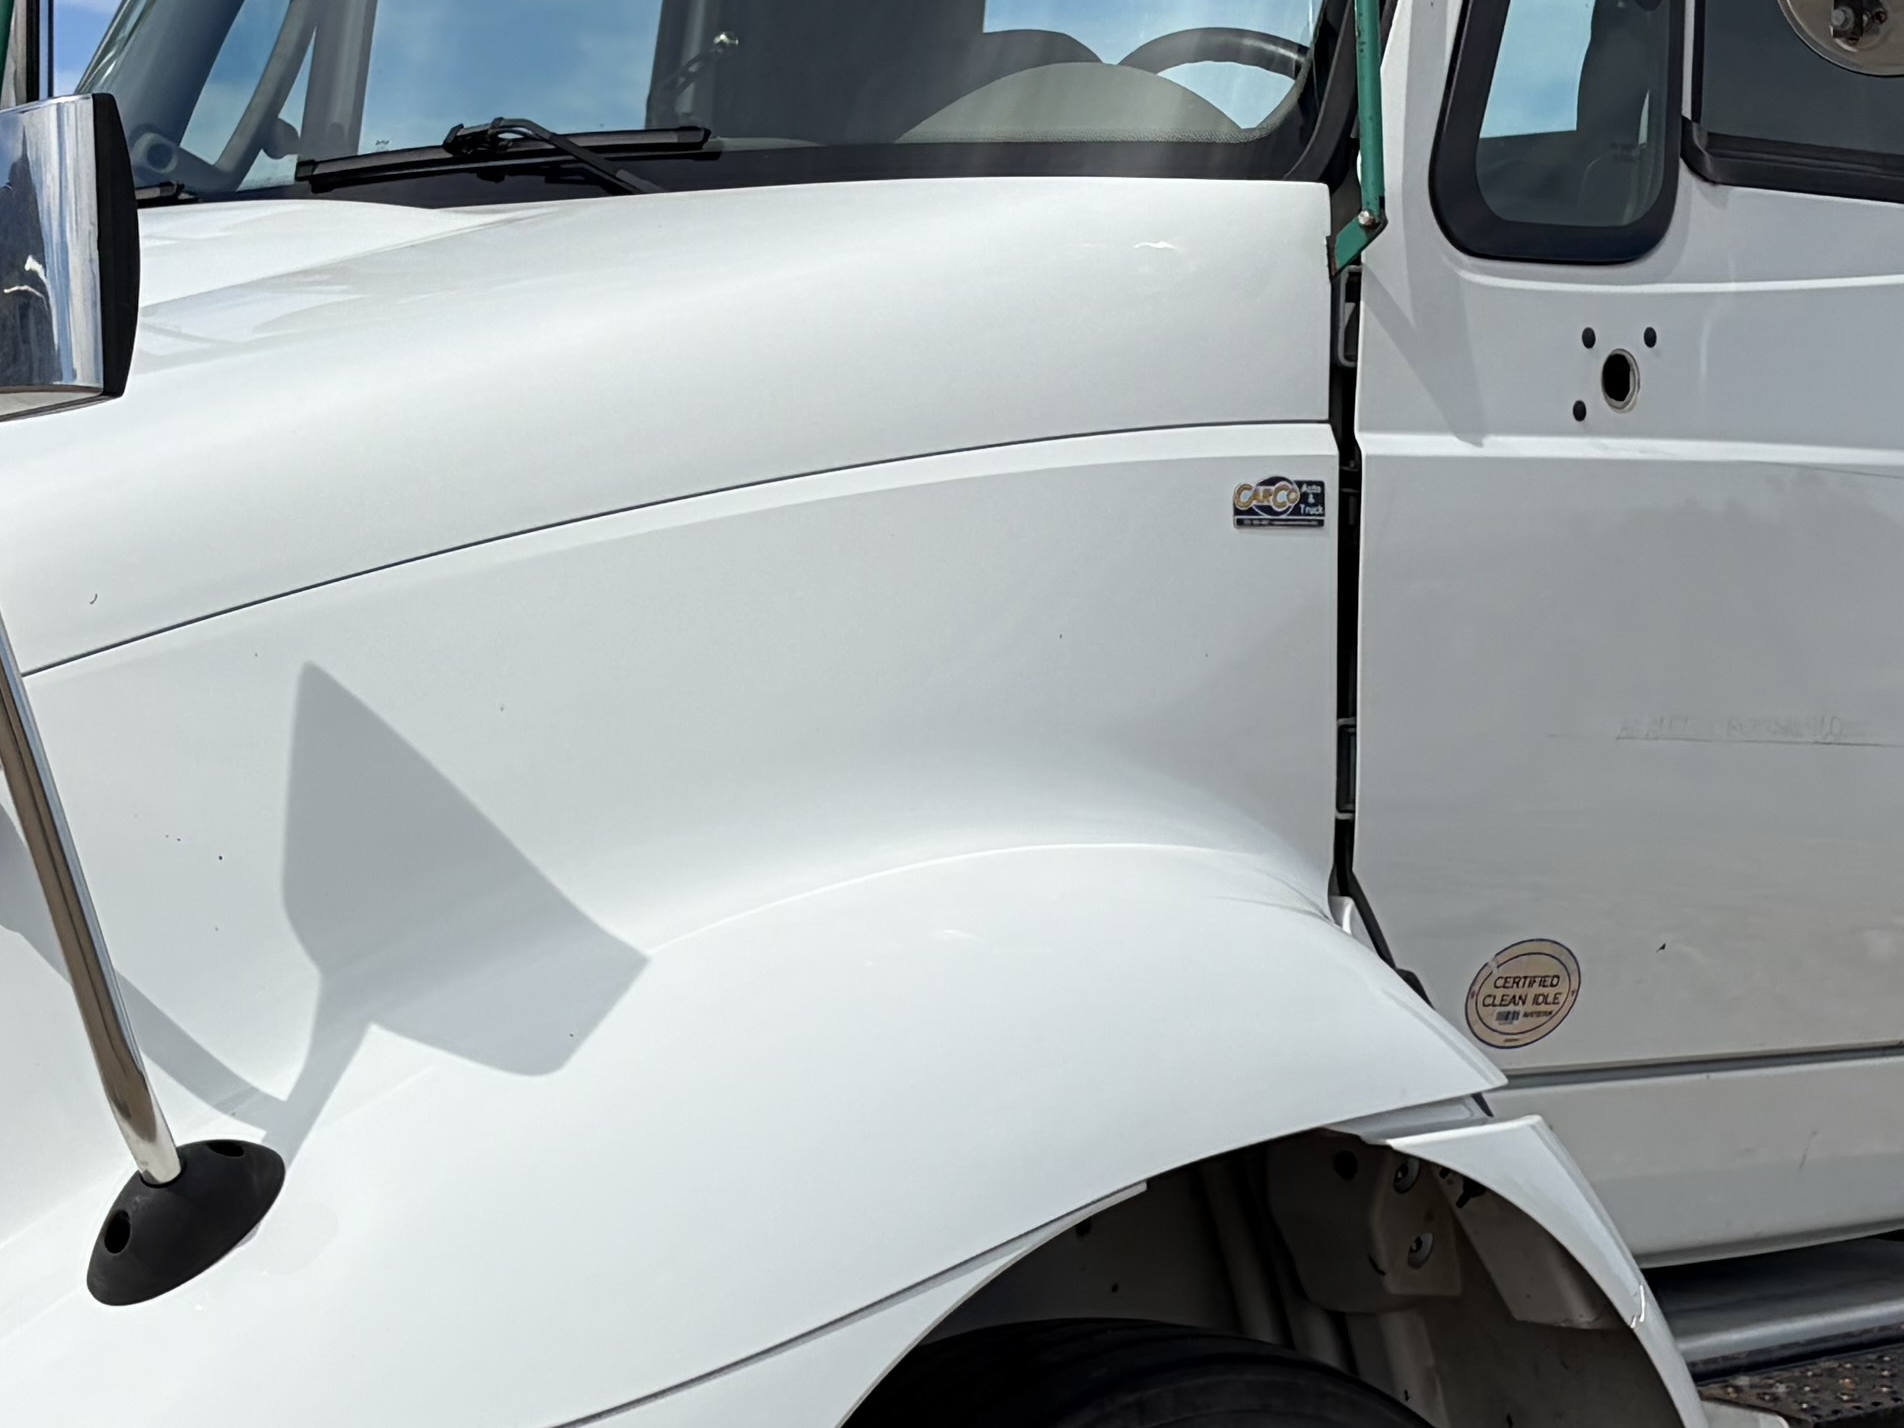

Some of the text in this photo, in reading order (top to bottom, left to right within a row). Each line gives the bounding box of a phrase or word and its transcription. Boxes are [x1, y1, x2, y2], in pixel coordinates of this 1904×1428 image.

[1299, 504, 1324, 515] Truck
[1493, 975, 1561, 989] CERTIFIED
[1482, 992, 1563, 1007] CLEAN IDLE
